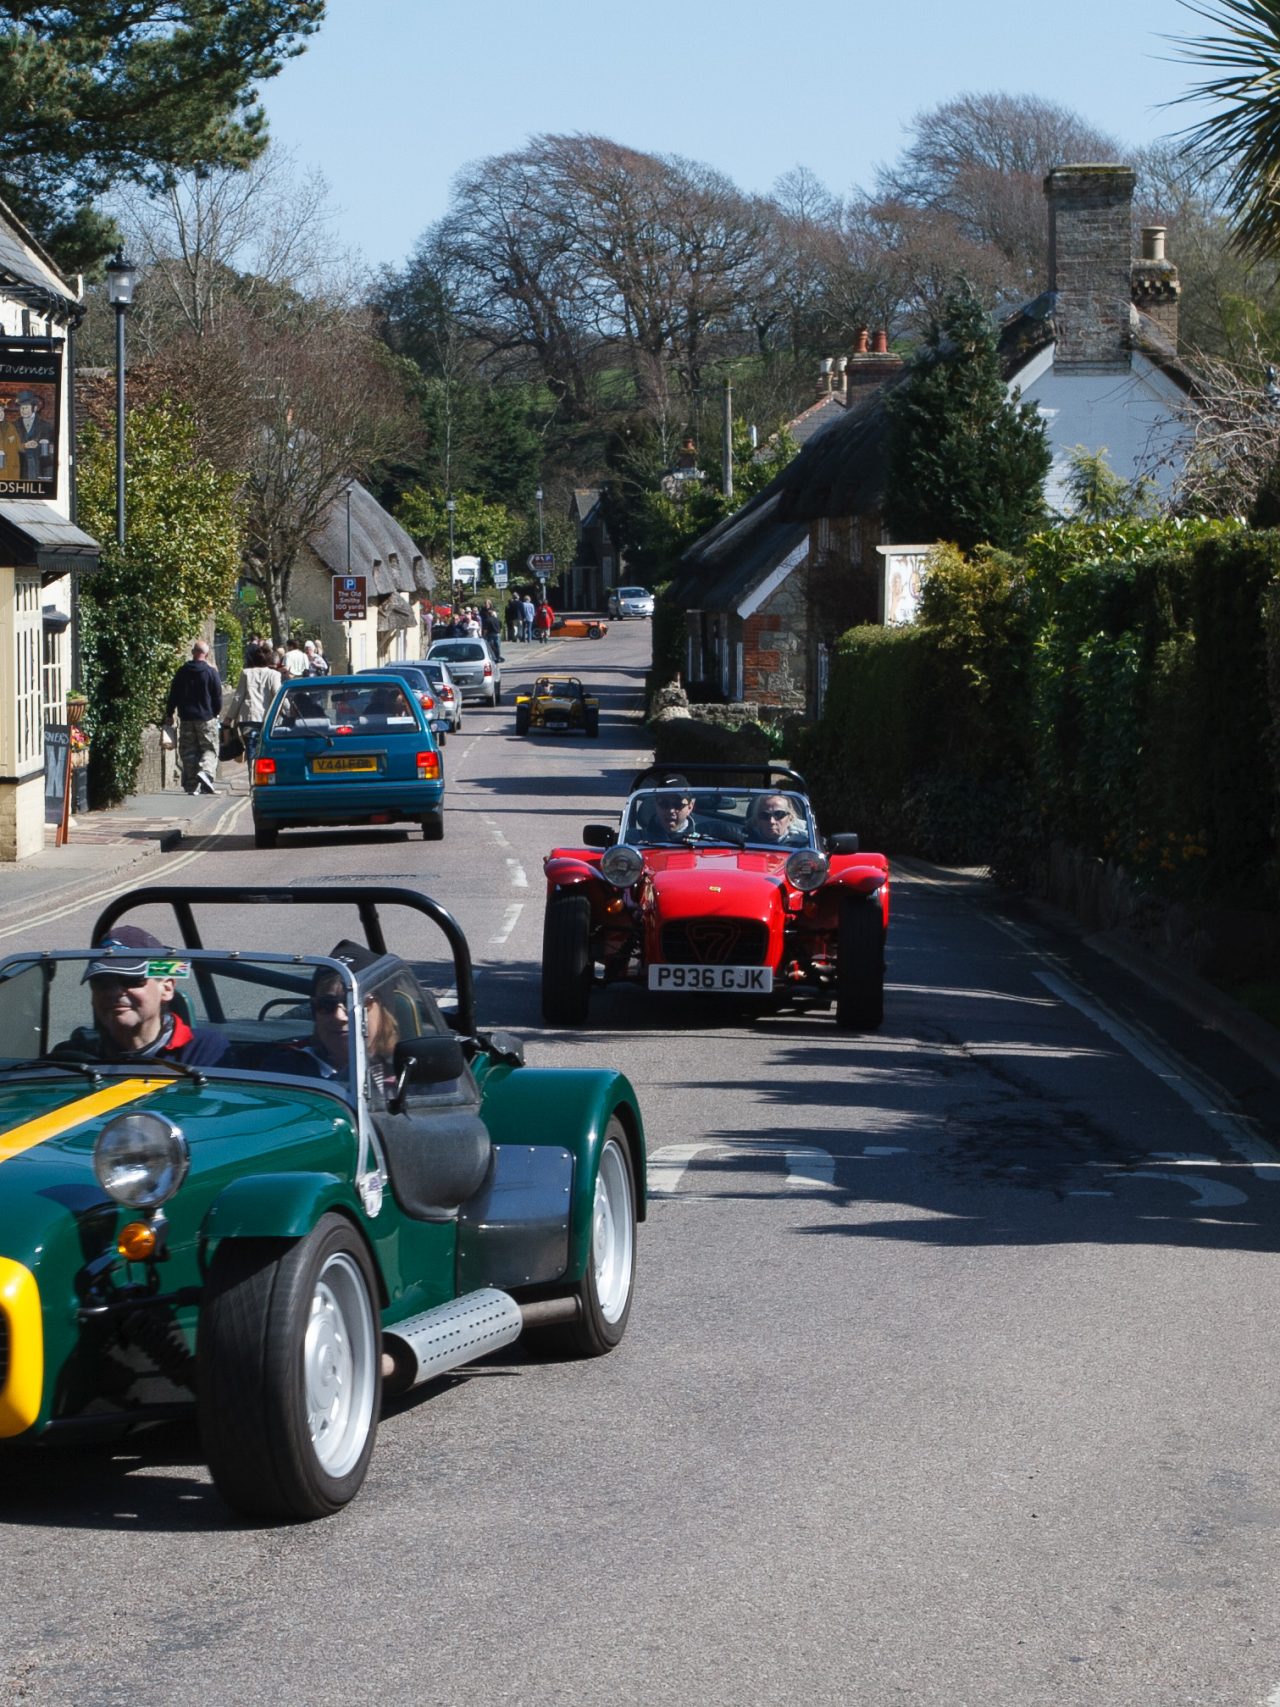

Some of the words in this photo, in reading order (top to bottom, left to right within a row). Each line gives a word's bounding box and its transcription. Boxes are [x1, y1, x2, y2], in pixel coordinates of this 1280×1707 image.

[495, 562, 505, 574] P
[346, 579, 354, 589] P
[657, 967, 716, 989] P936
[721, 969, 764, 989] GJK
